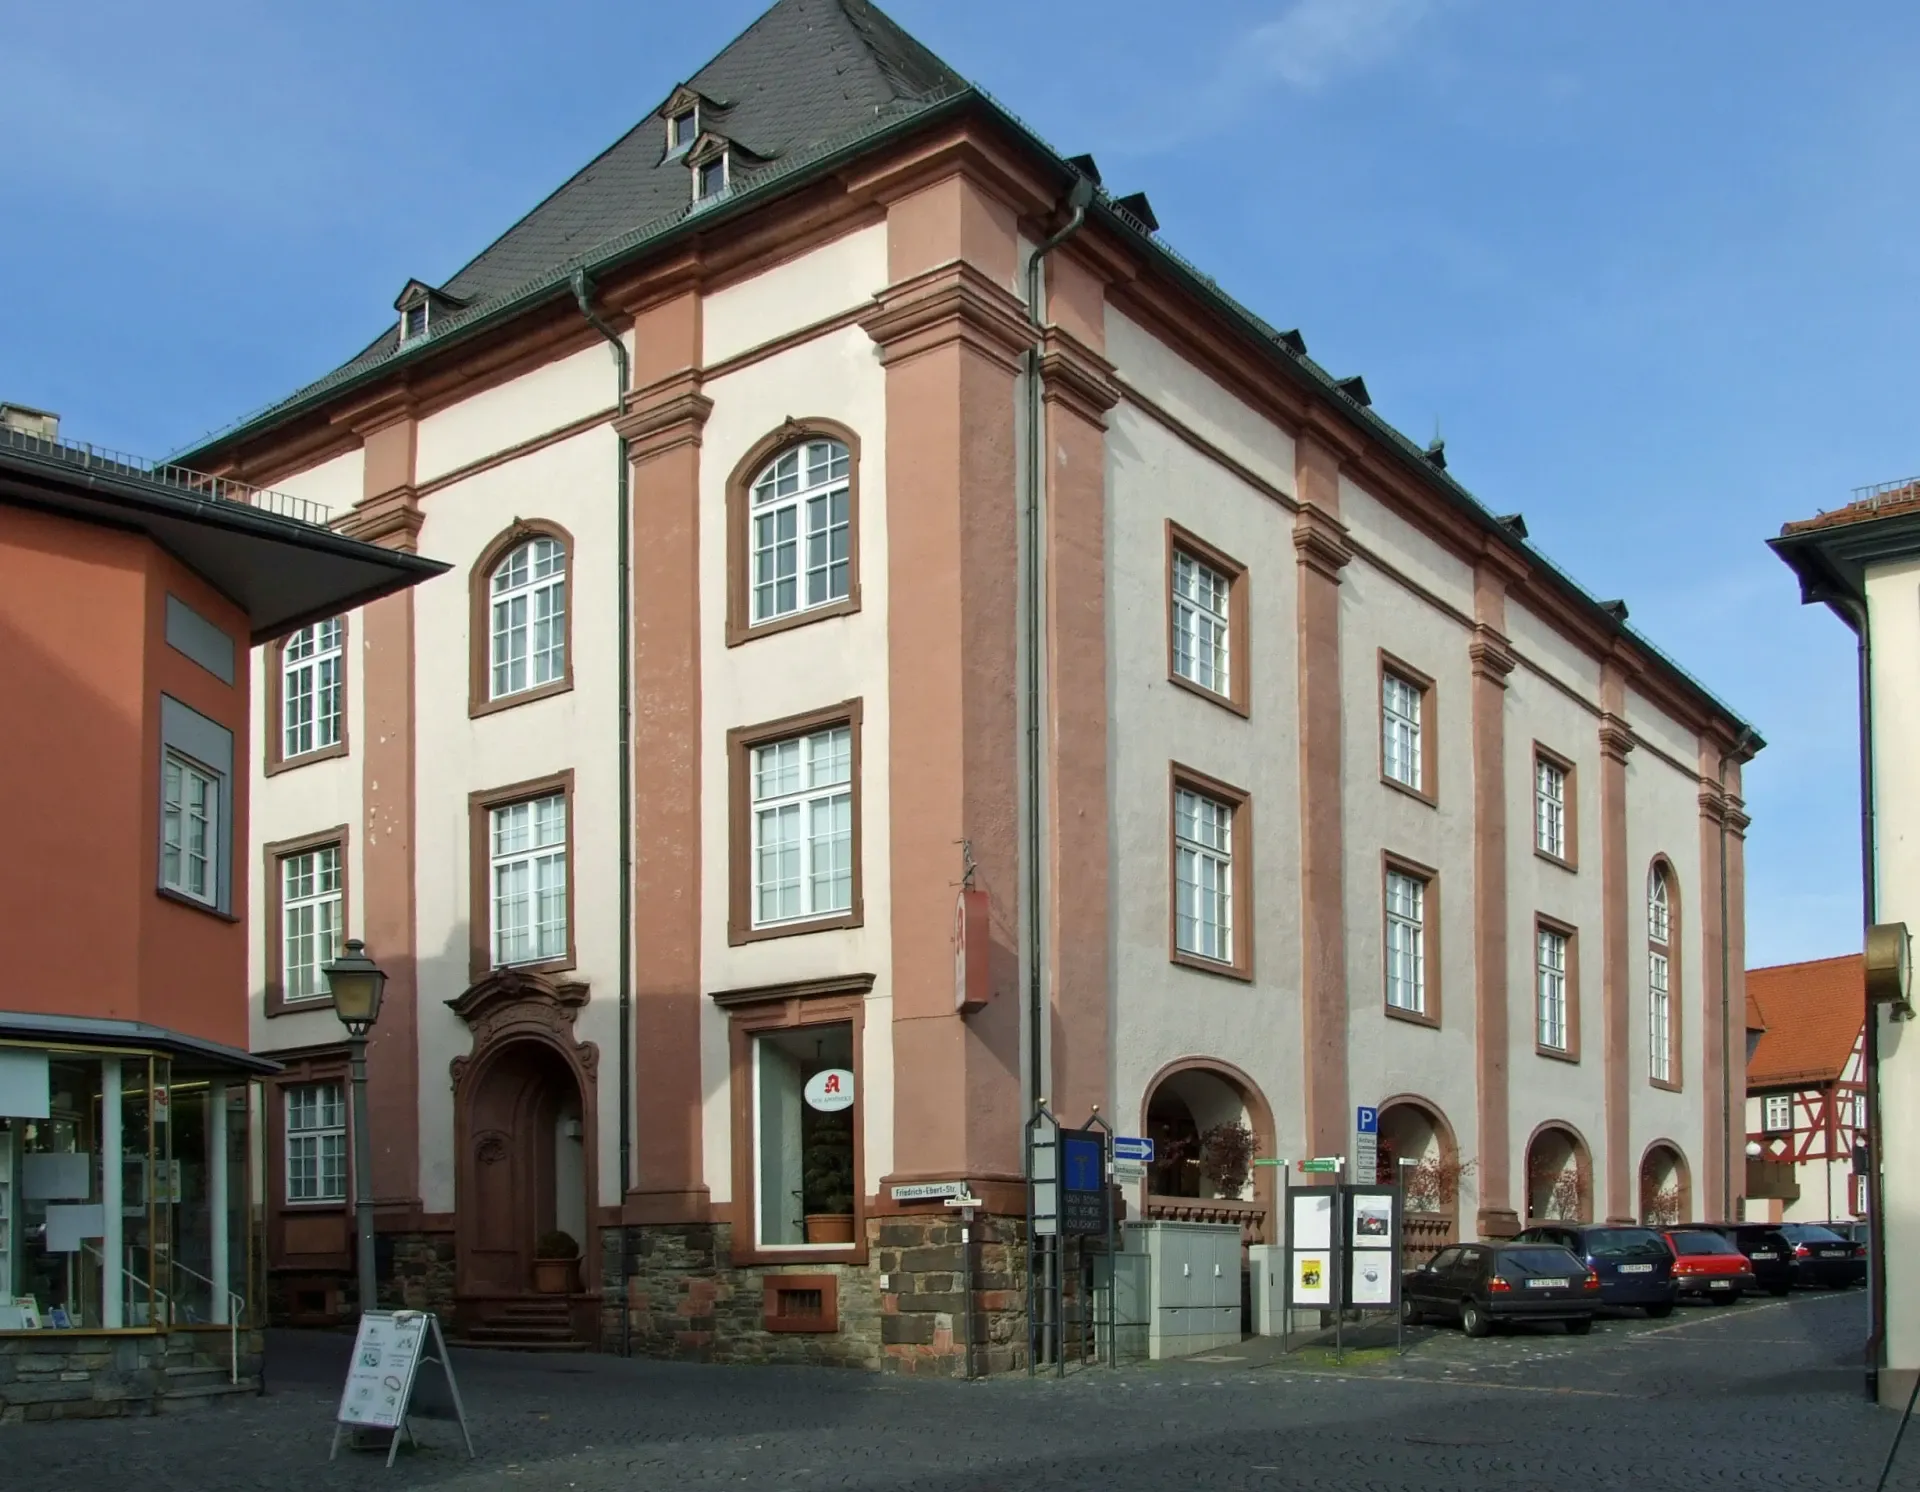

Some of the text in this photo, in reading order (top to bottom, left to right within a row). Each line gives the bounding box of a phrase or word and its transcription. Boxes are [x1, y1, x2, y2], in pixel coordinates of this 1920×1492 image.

[824, 1074, 840, 1093] A
[1361, 1110, 1373, 1130] P
[896, 1185, 957, 1197] Friedrich-Ebert-Str.
